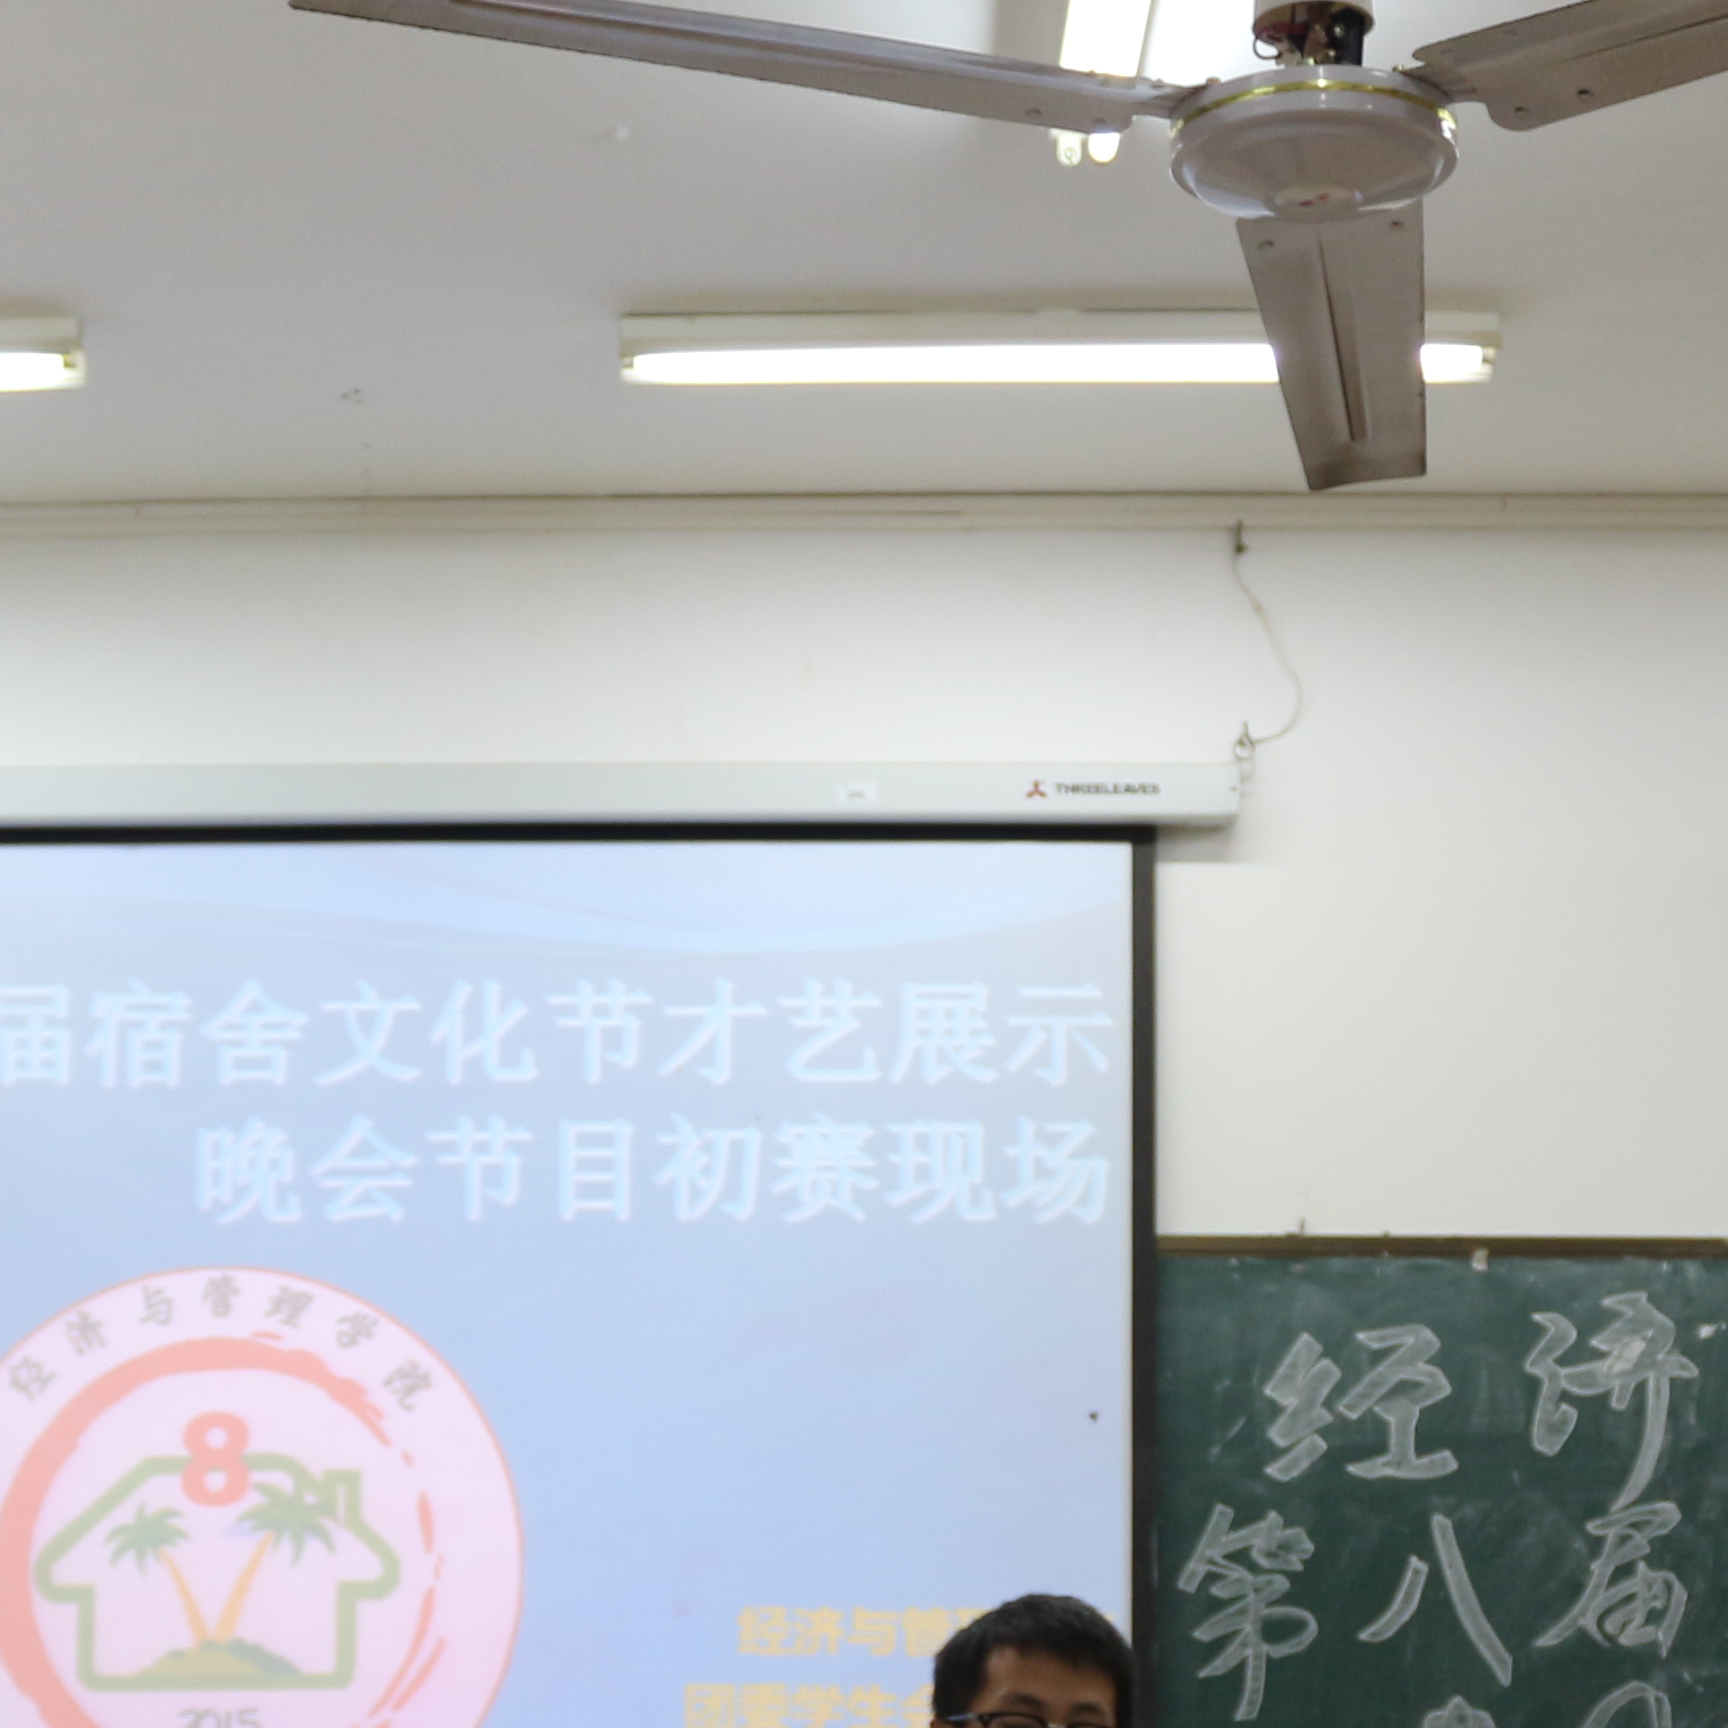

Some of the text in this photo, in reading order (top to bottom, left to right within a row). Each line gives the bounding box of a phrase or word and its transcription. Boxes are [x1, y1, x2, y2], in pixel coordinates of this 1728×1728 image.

[194, 1113, 1114, 1226] 晚会节目初赛现场
[6, 1273, 435, 1411] 经济与管理学院
[181, 1411, 251, 1508] 8
